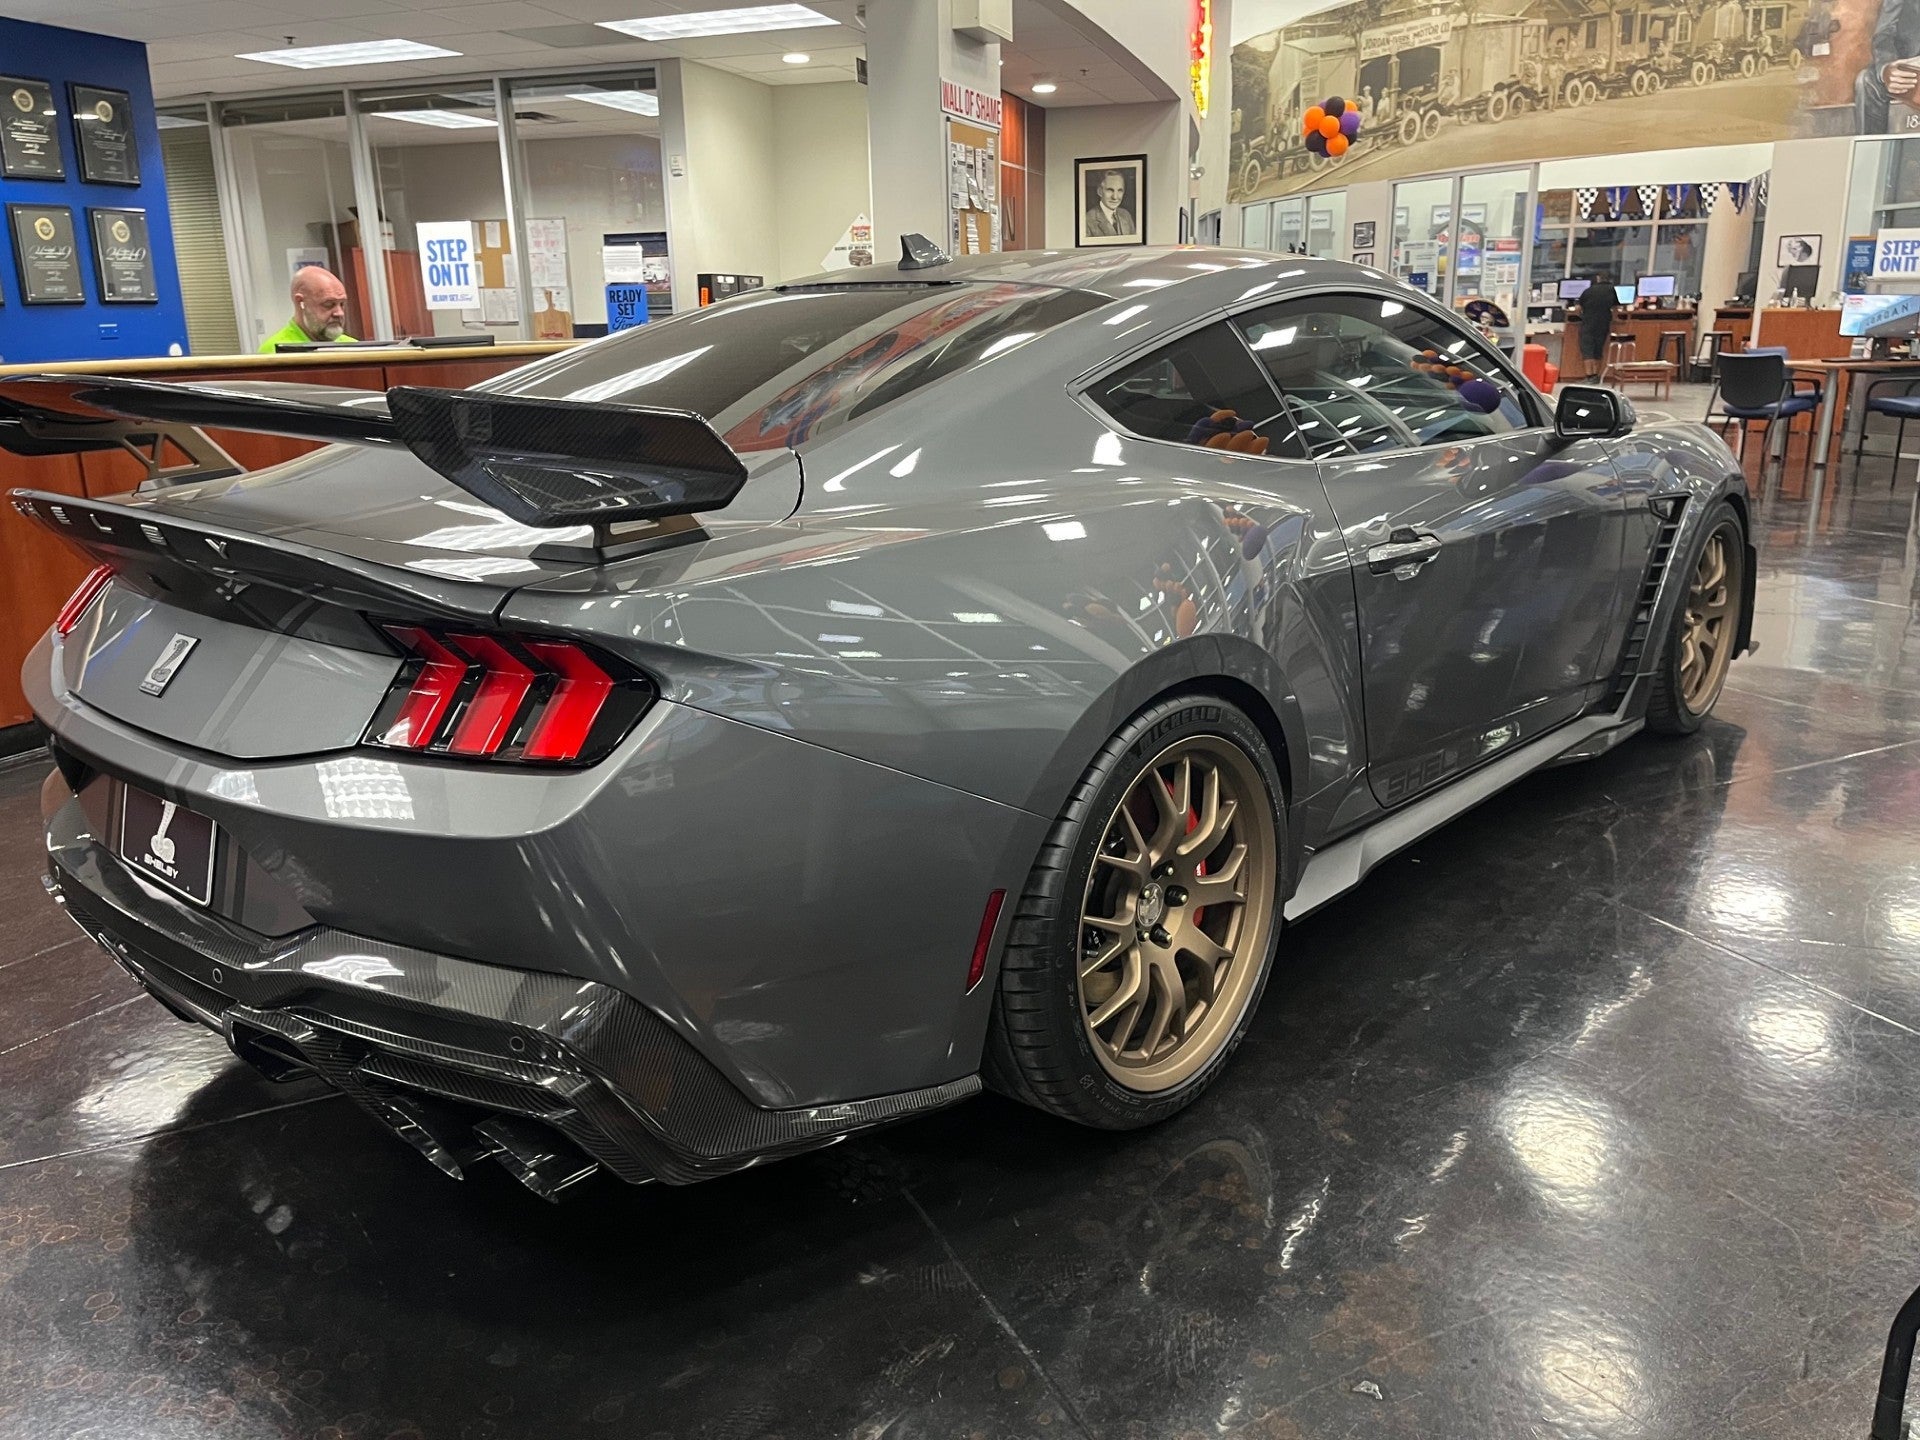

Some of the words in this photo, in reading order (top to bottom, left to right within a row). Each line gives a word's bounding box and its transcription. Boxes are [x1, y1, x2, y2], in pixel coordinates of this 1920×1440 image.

[942, 80, 963, 114] WALL
[965, 89, 974, 117] OF
[976, 92, 1001, 126] SHAME
[1906, 114, 1920, 129] 18
[426, 238, 467, 262] STEP
[1882, 240, 1920, 256] STEP
[428, 264, 453, 287] ON
[455, 263, 470, 286] IT
[1880, 257, 1902, 272] ON
[1903, 256, 1919, 272] IT
[609, 289, 642, 304] READY
[617, 303, 635, 316] SET
[11, 501, 229, 559] SHELBY
[1138, 706, 1219, 755] MICHELIN
[144, 853, 179, 879] SHELBY
